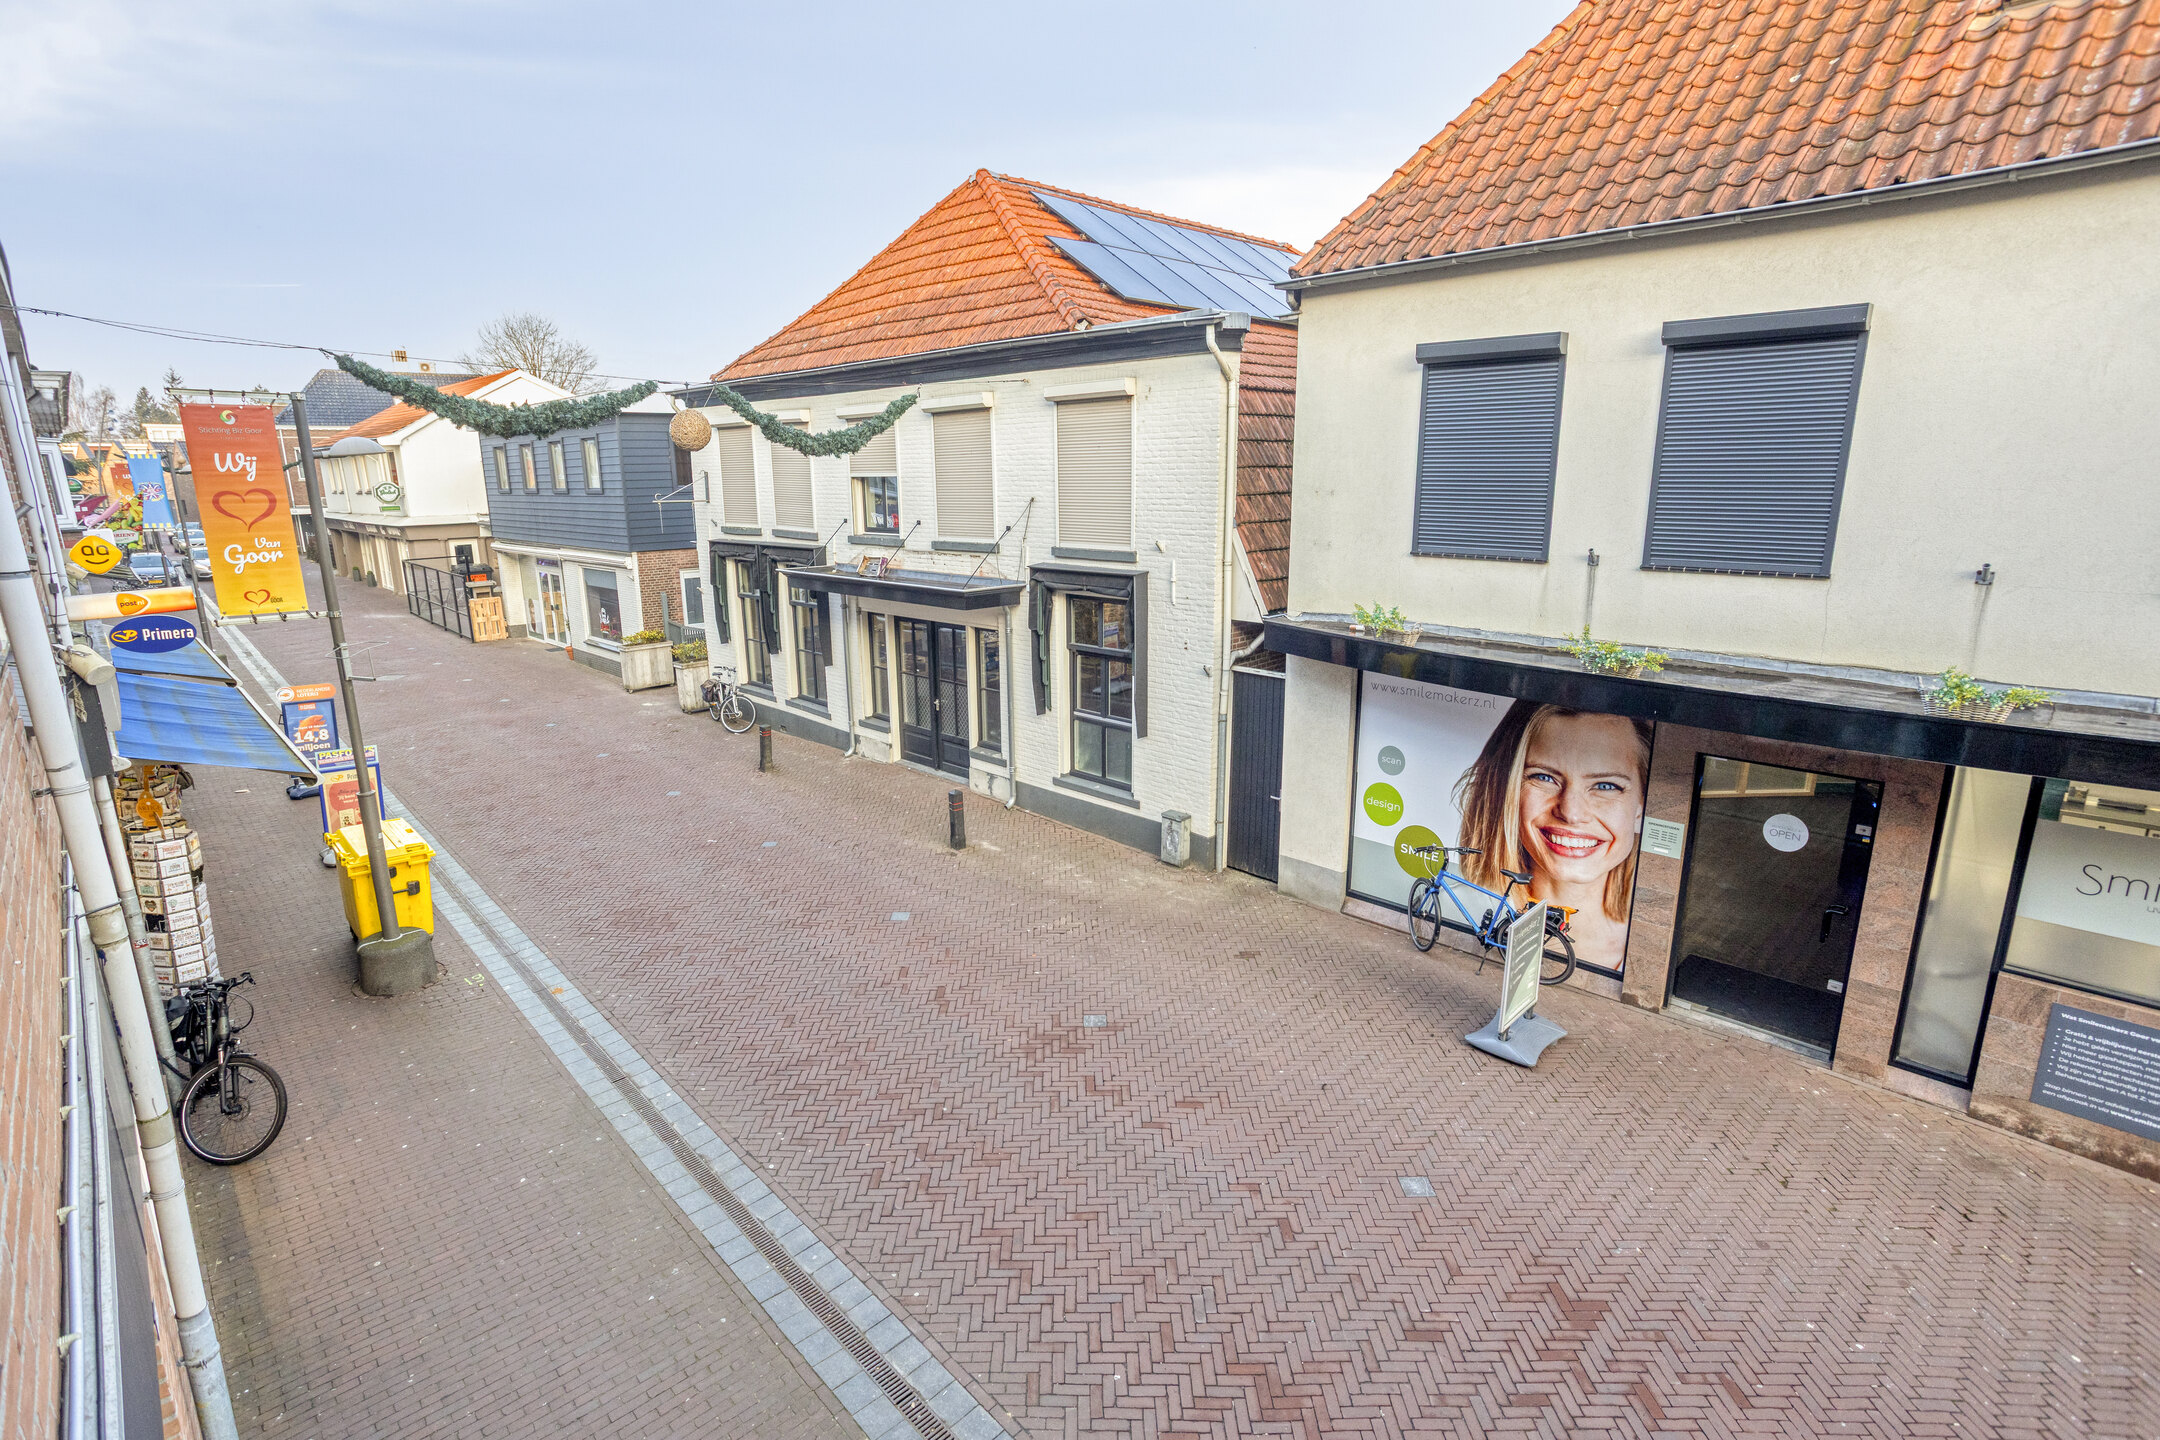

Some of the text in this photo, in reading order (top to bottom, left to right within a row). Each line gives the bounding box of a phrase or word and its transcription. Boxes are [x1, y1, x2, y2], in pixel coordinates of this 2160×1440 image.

[198, 426, 231, 435] Stichting
[213, 452, 258, 482] Wij
[254, 537, 281, 549] Van
[223, 543, 284, 575] Goor
[141, 628, 195, 641] Primera
[1370, 681, 1497, 710] www.smilemakerz.nl
[293, 728, 330, 744] 14,8
[1381, 756, 1402, 766] scan
[1366, 796, 1401, 812] design
[1769, 828, 1801, 842] OPEN
[2061, 1012, 2078, 1021] Wat
[2078, 1017, 2129, 1035] Smilemakerz
[2130, 1031, 2150, 1040] Goor
[2061, 1043, 2077, 1051] Niet
[2078, 1048, 2097, 1056] meer
[2065, 1029, 2087, 1038] Gratis
[2094, 1037, 2137, 1052] vrijblijvend
[2072, 1038, 2090, 1047] hebt
[2111, 1050, 2149, 1065] verwijzing
[2058, 1056, 2069, 1064] De
[2069, 1061, 2102, 1074] rekening
[2103, 1070, 2121, 1078] gaat
[2060, 1050, 2072, 1058] Wij
[2072, 1053, 2101, 1065] hebben
[2101, 1062, 2143, 1077] contracten
[2055, 1070, 2105, 1089] Behandelplan
[2105, 1086, 2120, 1094] van
[2056, 1063, 2069, 1072] Wij
[2069, 1067, 2082, 1075] zijn
[2082, 1071, 2097, 1079] ook
[2097, 1076, 2137, 1092] deskundig
[2042, 1089, 2056, 1097] een
[2056, 1094, 2089, 1107] afspraak
[2043, 1082, 2061, 1091] Stap
[2061, 1087, 2088, 1099] binnen
[2088, 1095, 2105, 1104] voor
[2105, 1101, 2130, 1112] advies
